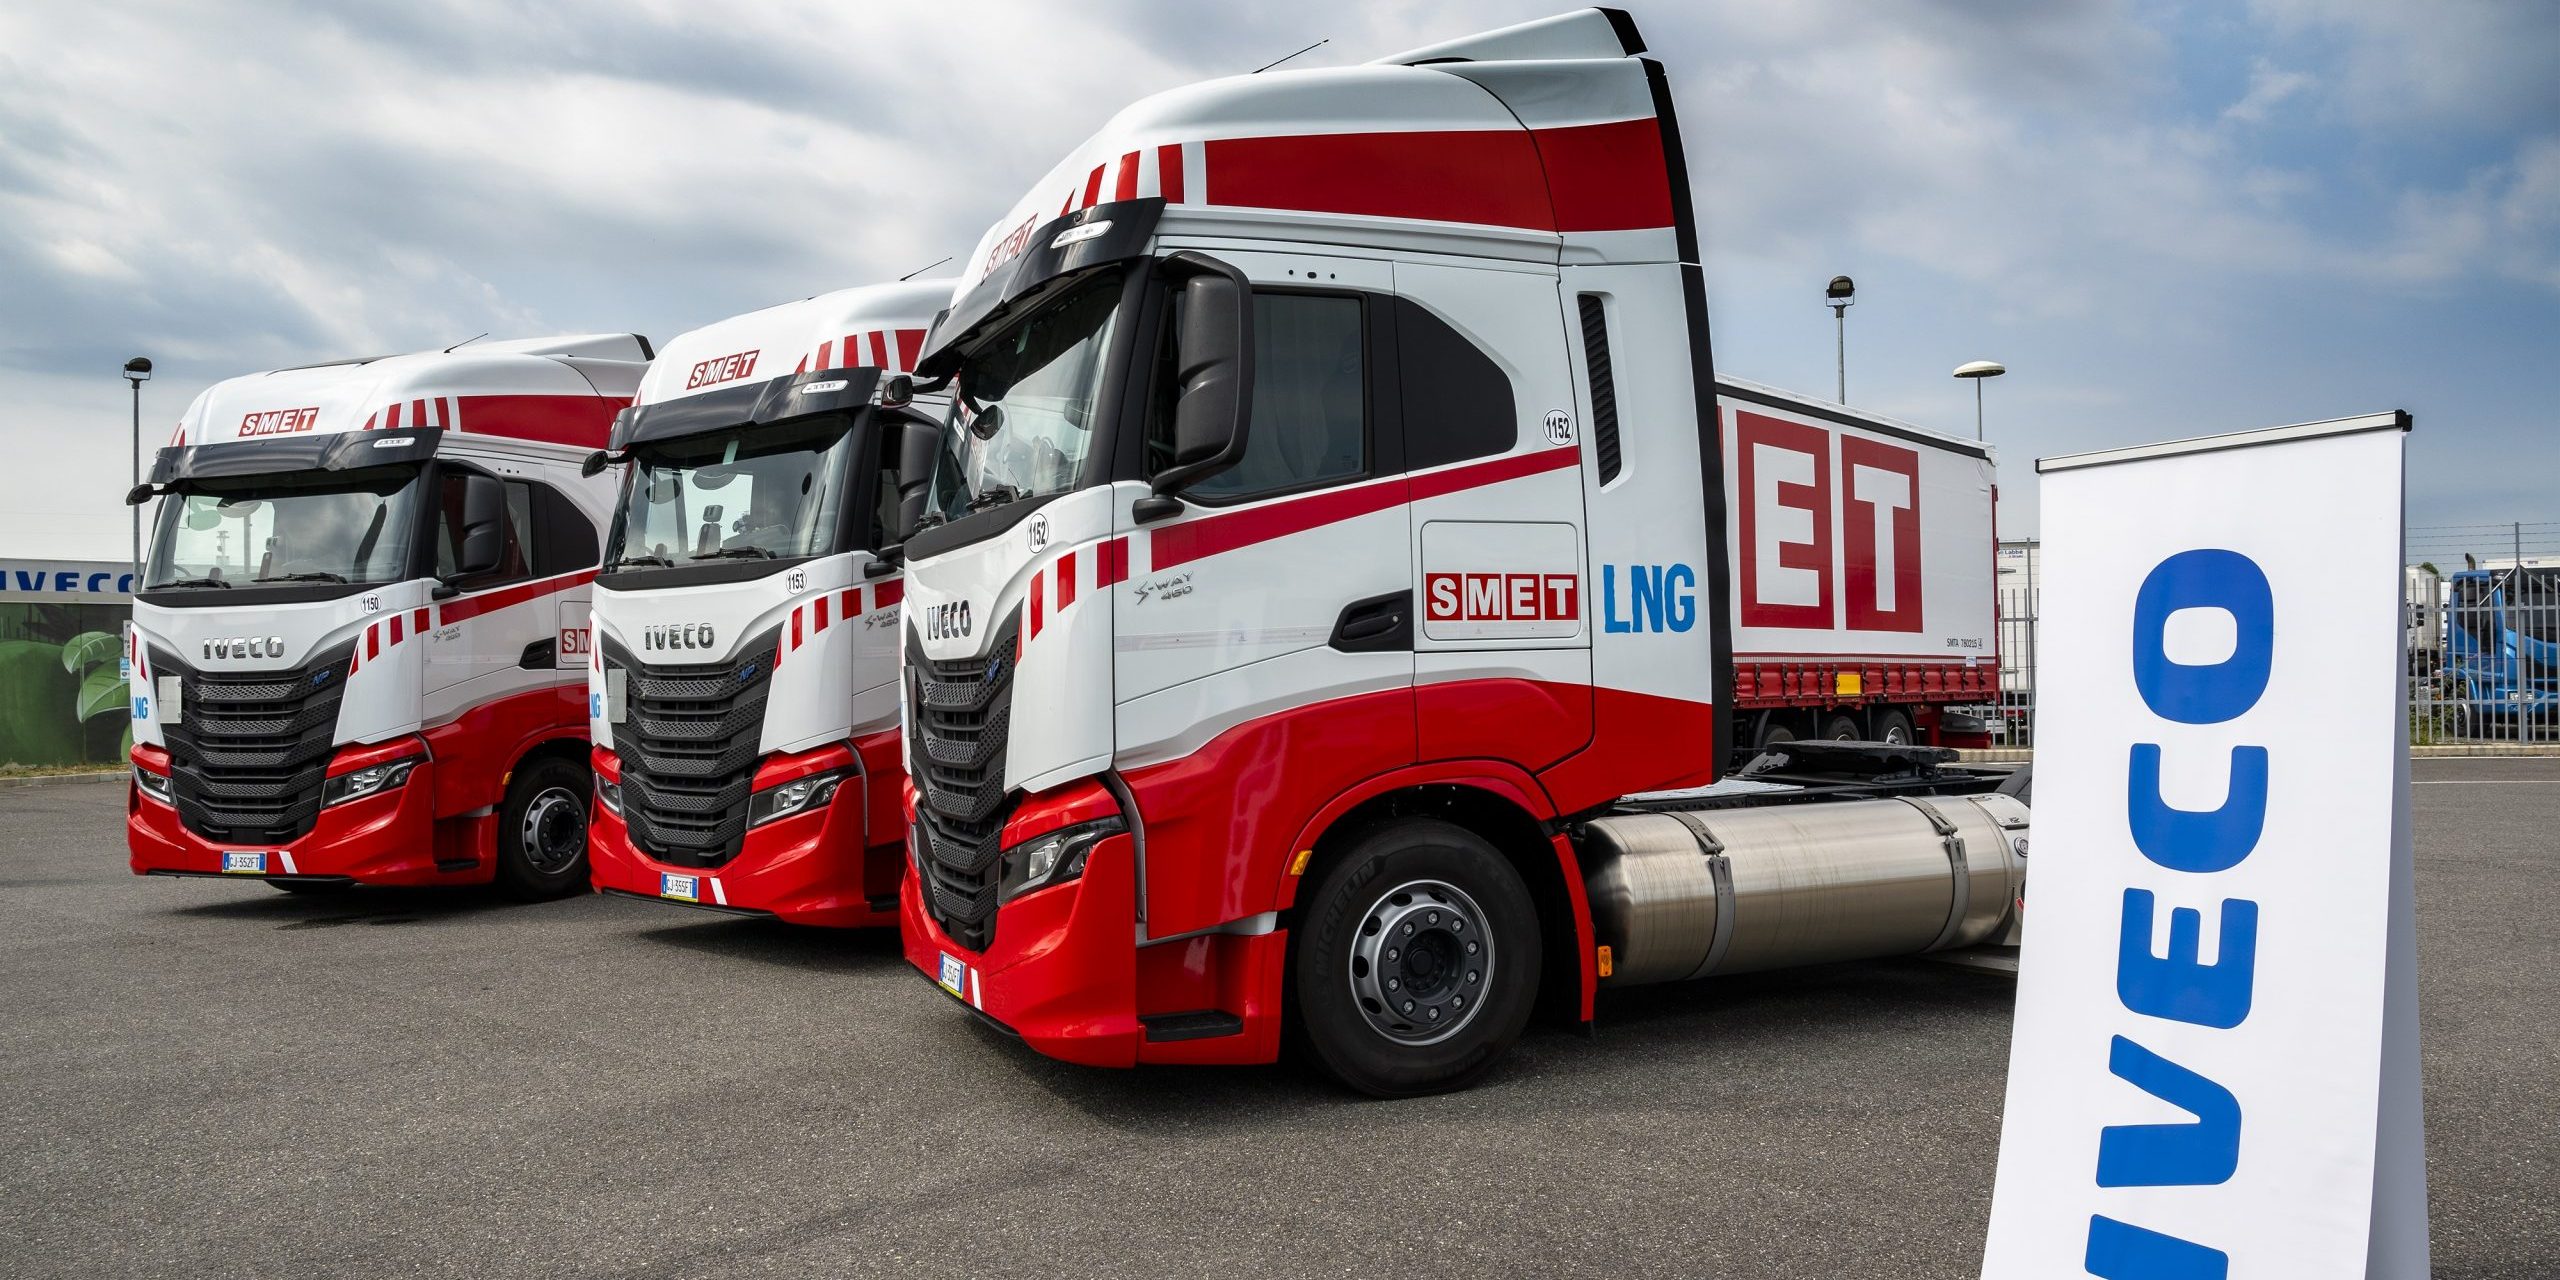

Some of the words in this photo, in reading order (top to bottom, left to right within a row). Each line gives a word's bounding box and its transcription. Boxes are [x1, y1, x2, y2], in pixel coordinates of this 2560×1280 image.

[690, 353, 758, 388] SMET
[241, 407, 316, 436] SMET
[1545, 417, 1571, 439] 1152
[1028, 520, 1046, 547] 1152
[788, 573, 804, 590] 1153
[1134, 571, 1194, 605] S-WAY
[1161, 584, 1193, 600] 460
[362, 596, 379, 611] 1150
[1430, 577, 1574, 616] SMET
[1603, 563, 1696, 634] LNG
[926, 599, 972, 641] IVECO
[203, 636, 285, 660] IVECO
[644, 622, 715, 651] IVECO
[311, 670, 331, 687] NP
[739, 664, 757, 682] NP
[2084, 548, 2274, 1280] IVECO
